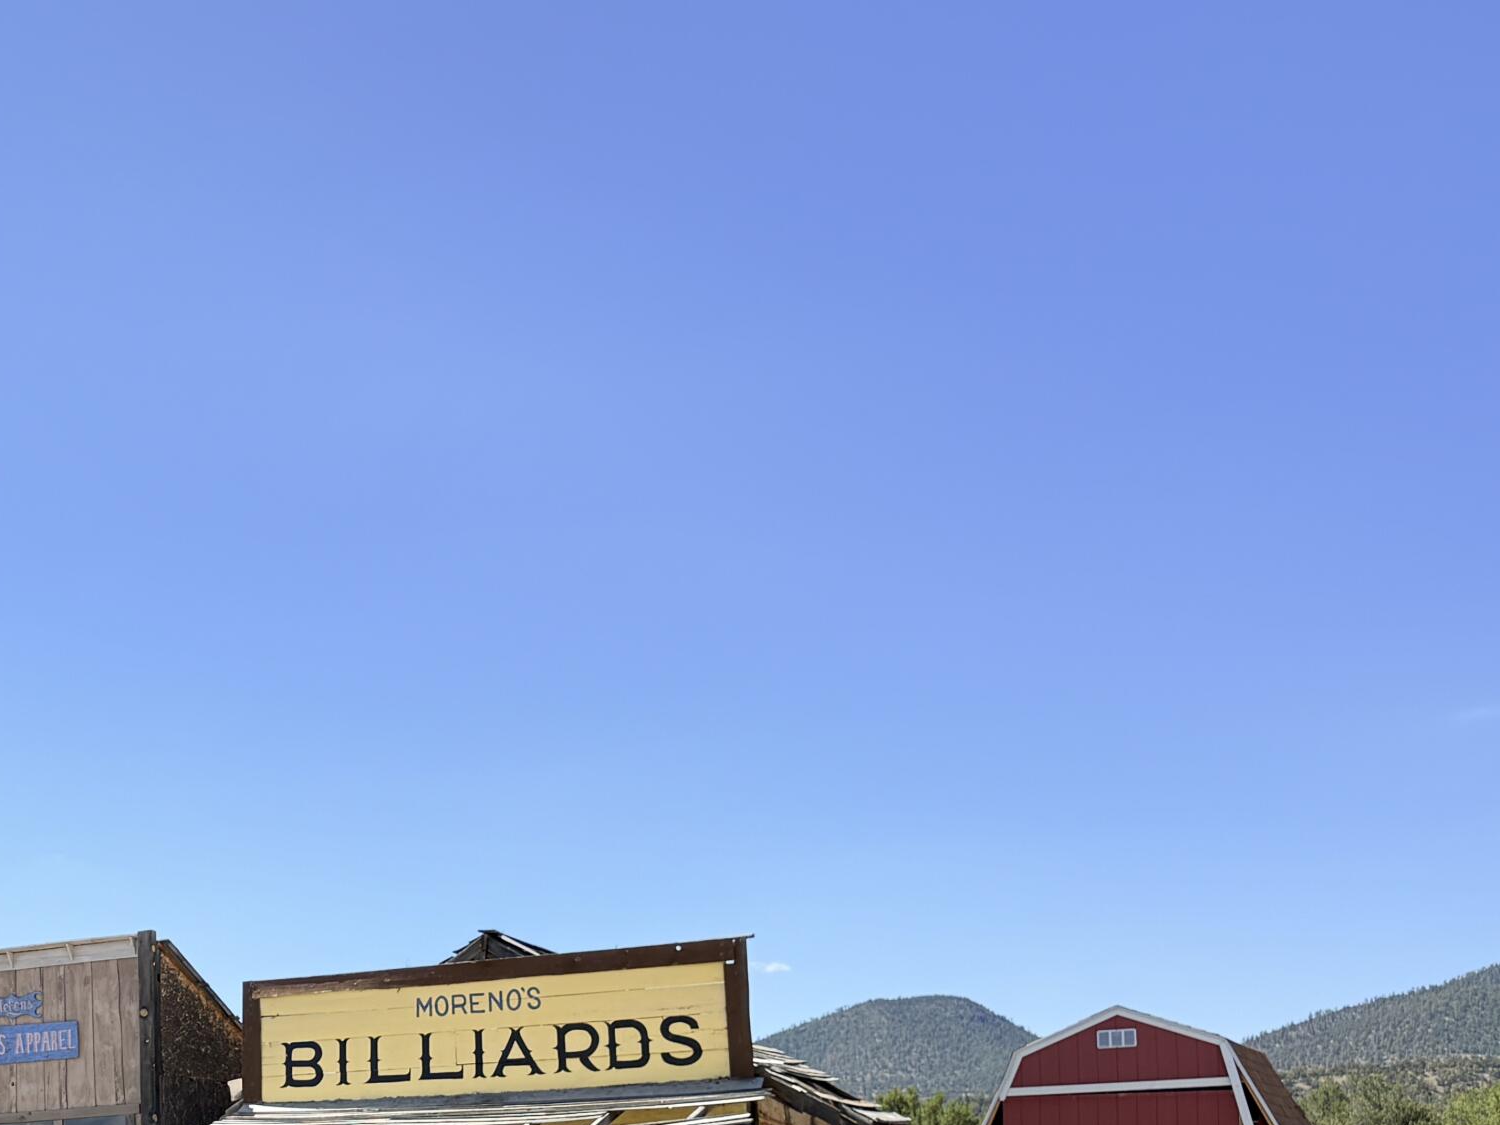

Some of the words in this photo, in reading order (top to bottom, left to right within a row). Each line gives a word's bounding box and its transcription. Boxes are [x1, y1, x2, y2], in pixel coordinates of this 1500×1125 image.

[416, 986, 542, 1018] MORENO'S
[15, 1029, 76, 1055] APPAREL
[280, 1015, 703, 1088] BILLIARDS
